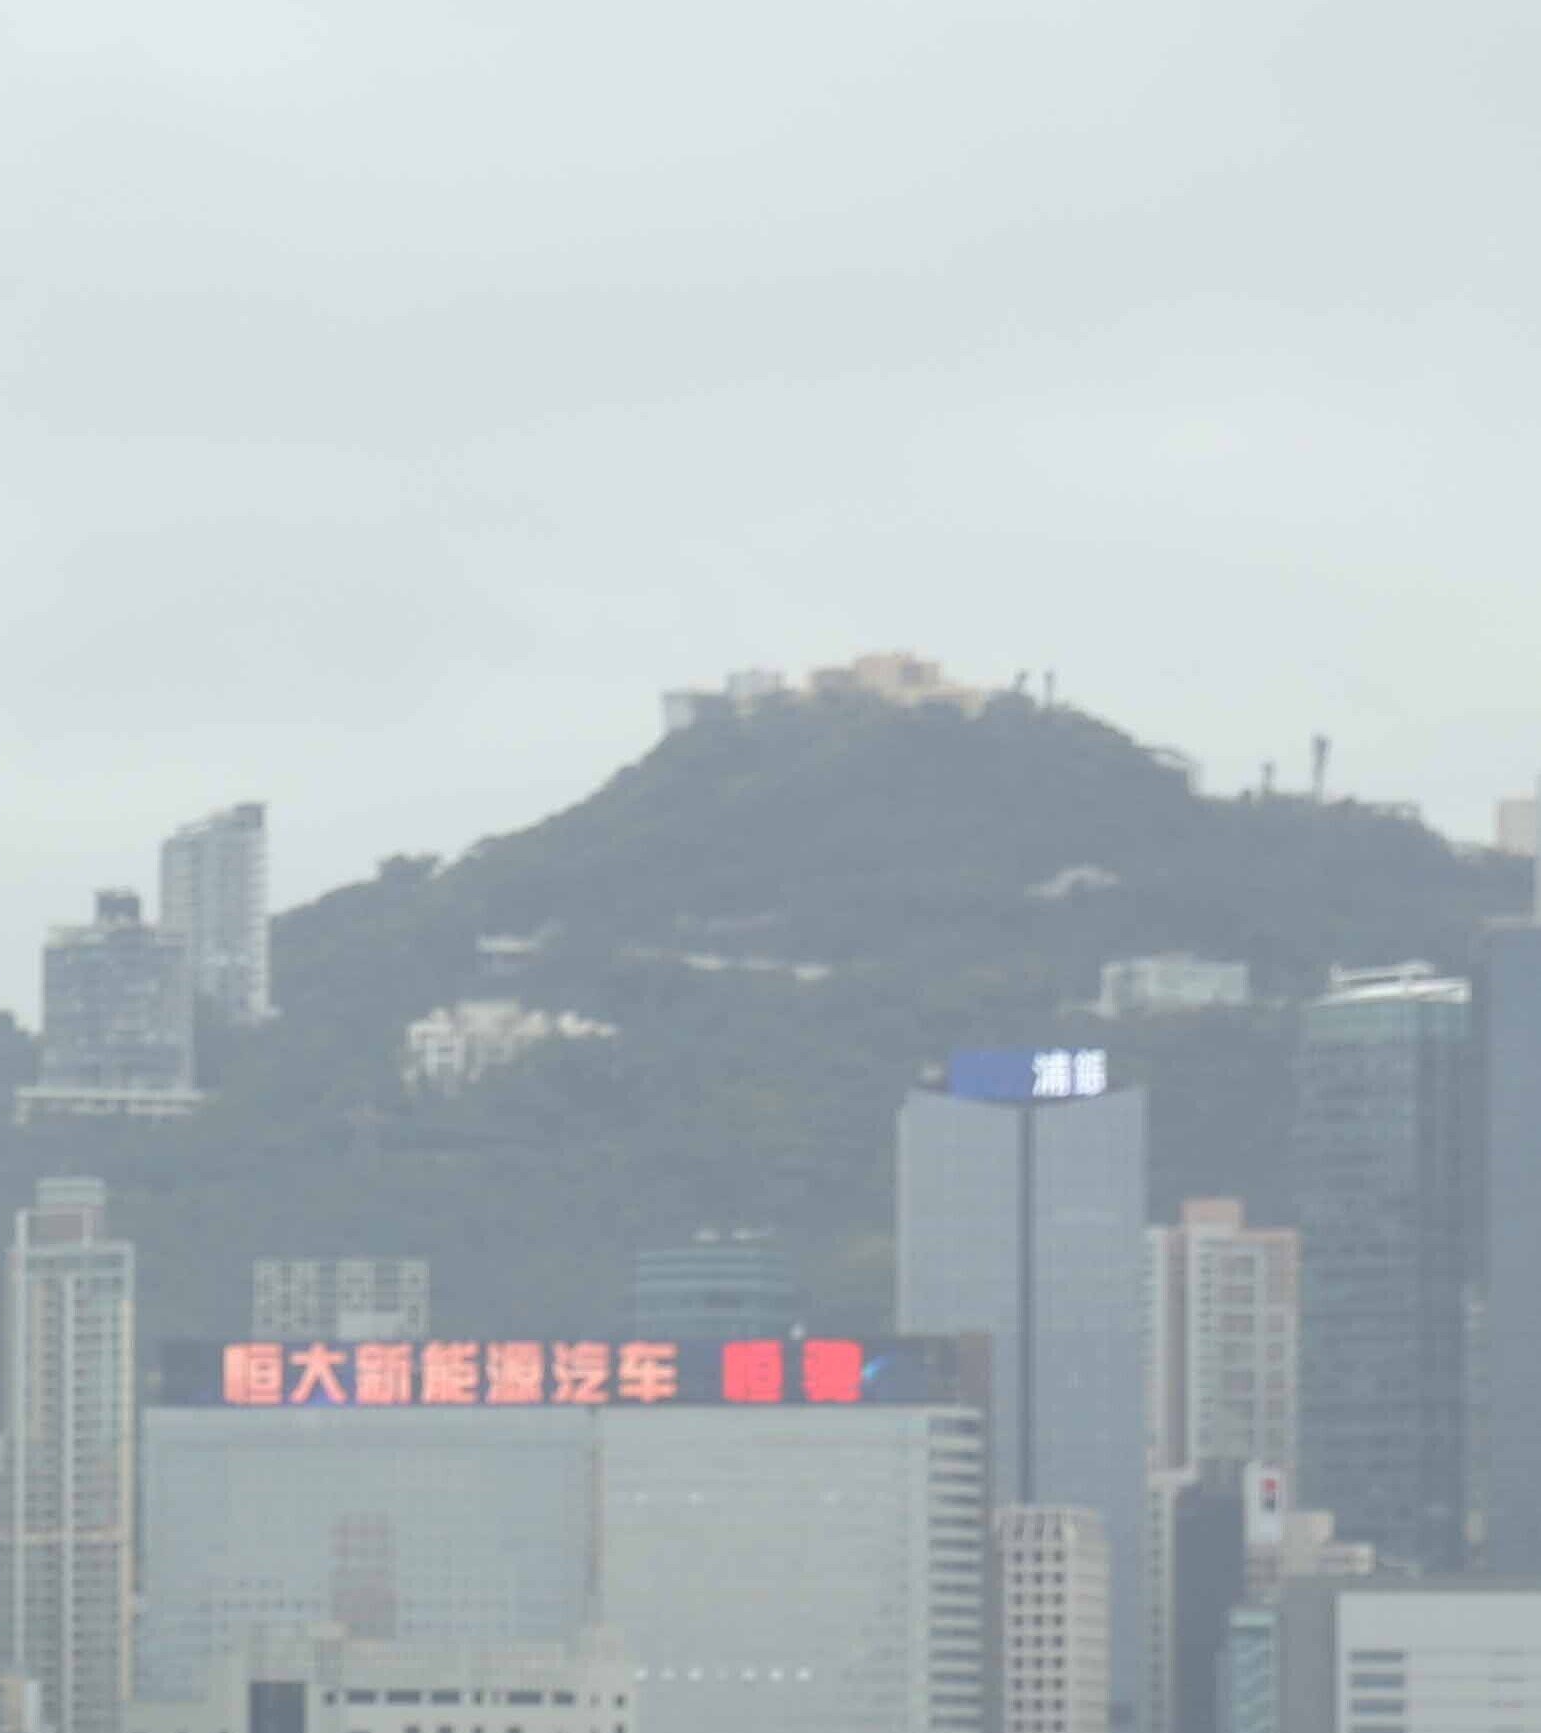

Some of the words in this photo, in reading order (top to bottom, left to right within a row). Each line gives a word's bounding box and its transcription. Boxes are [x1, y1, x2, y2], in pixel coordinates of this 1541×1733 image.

[223, 1340, 677, 1404] 恒大新能源汽车
